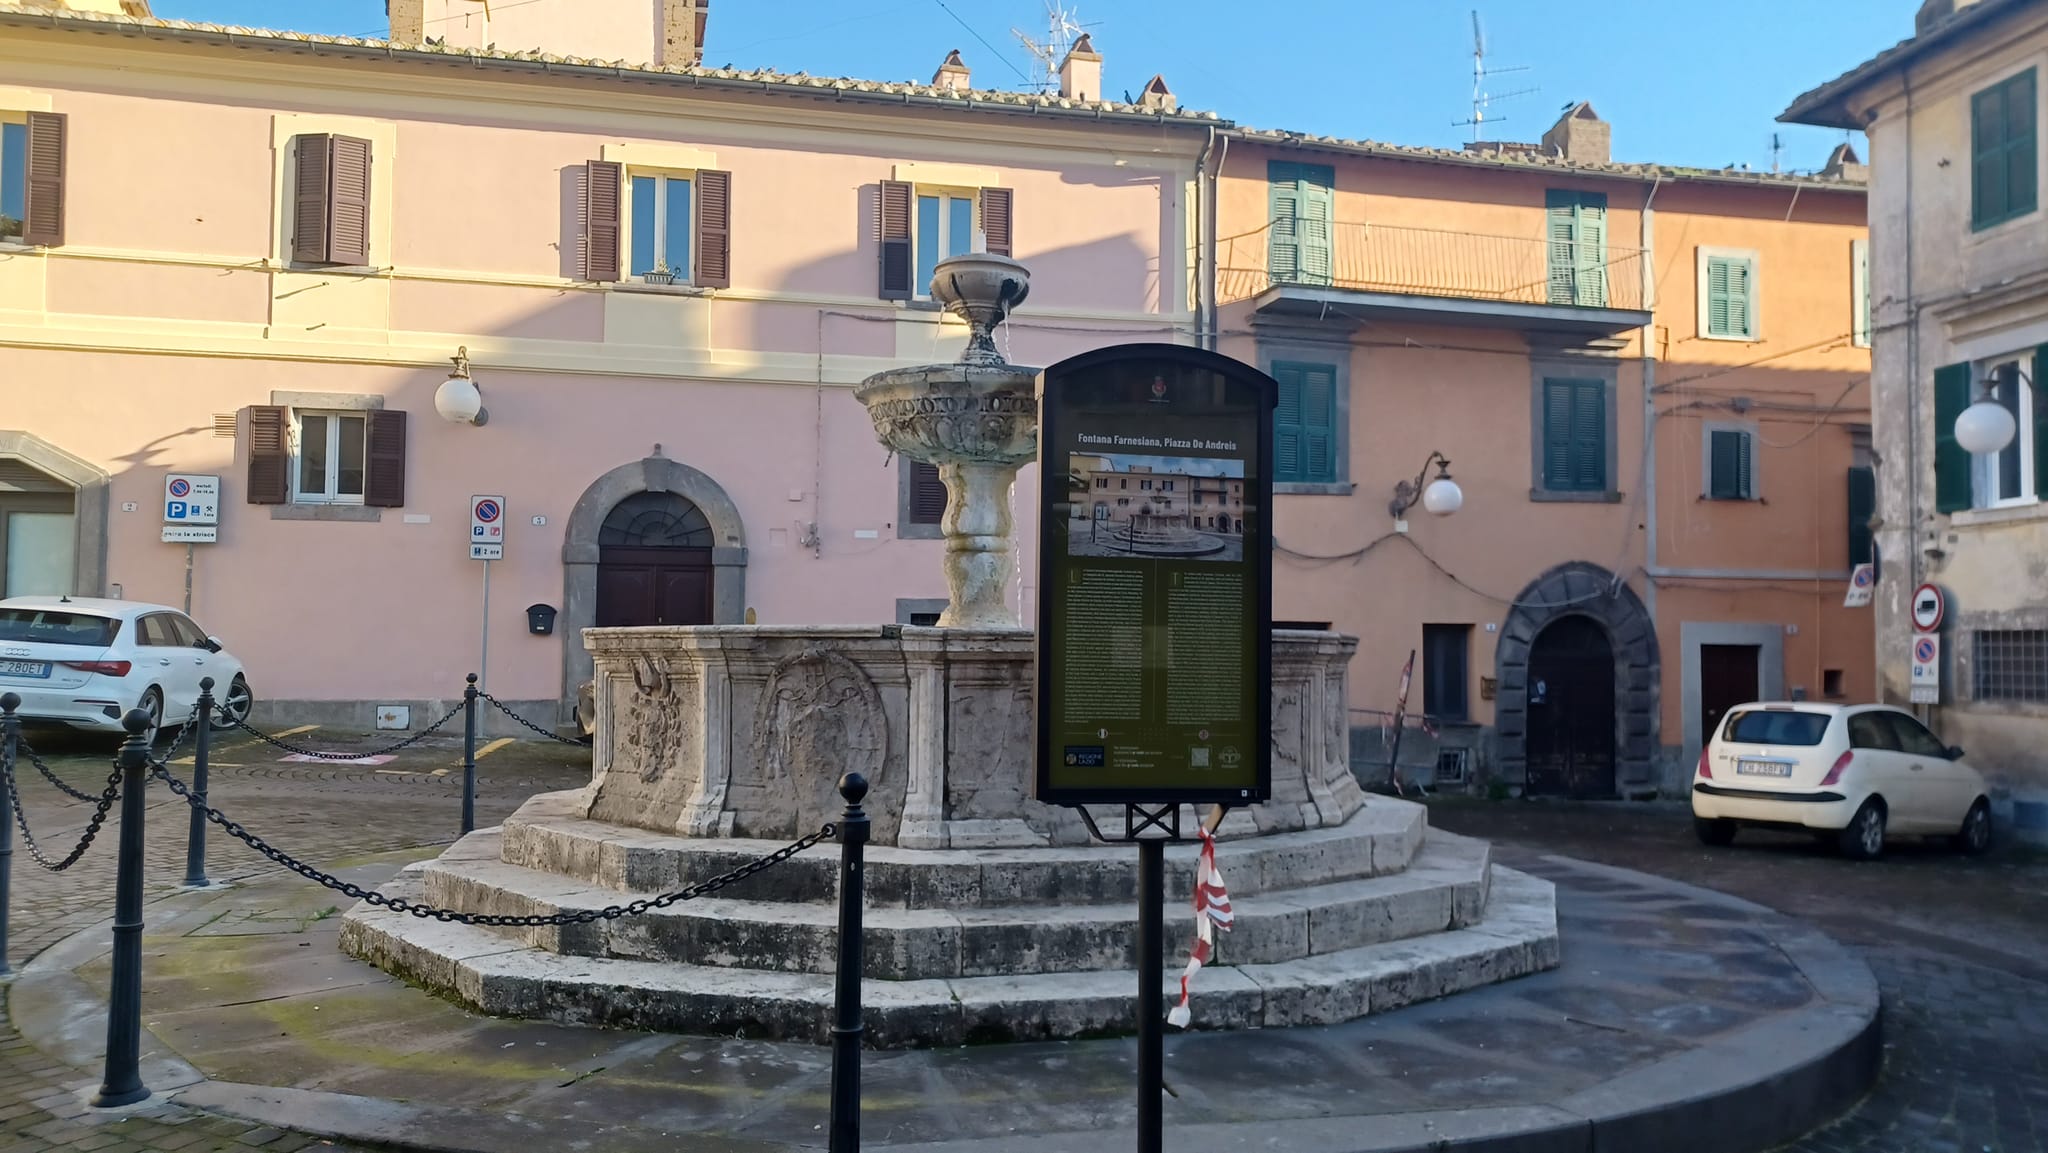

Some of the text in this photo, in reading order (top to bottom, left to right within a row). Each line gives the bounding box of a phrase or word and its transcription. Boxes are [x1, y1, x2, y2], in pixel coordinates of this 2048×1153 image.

[1078, 433, 1237, 451] Fontana Farnesiana, Piazza De Andreis
[171, 503, 183, 516] P
[8, 662, 43, 674] 280ET
